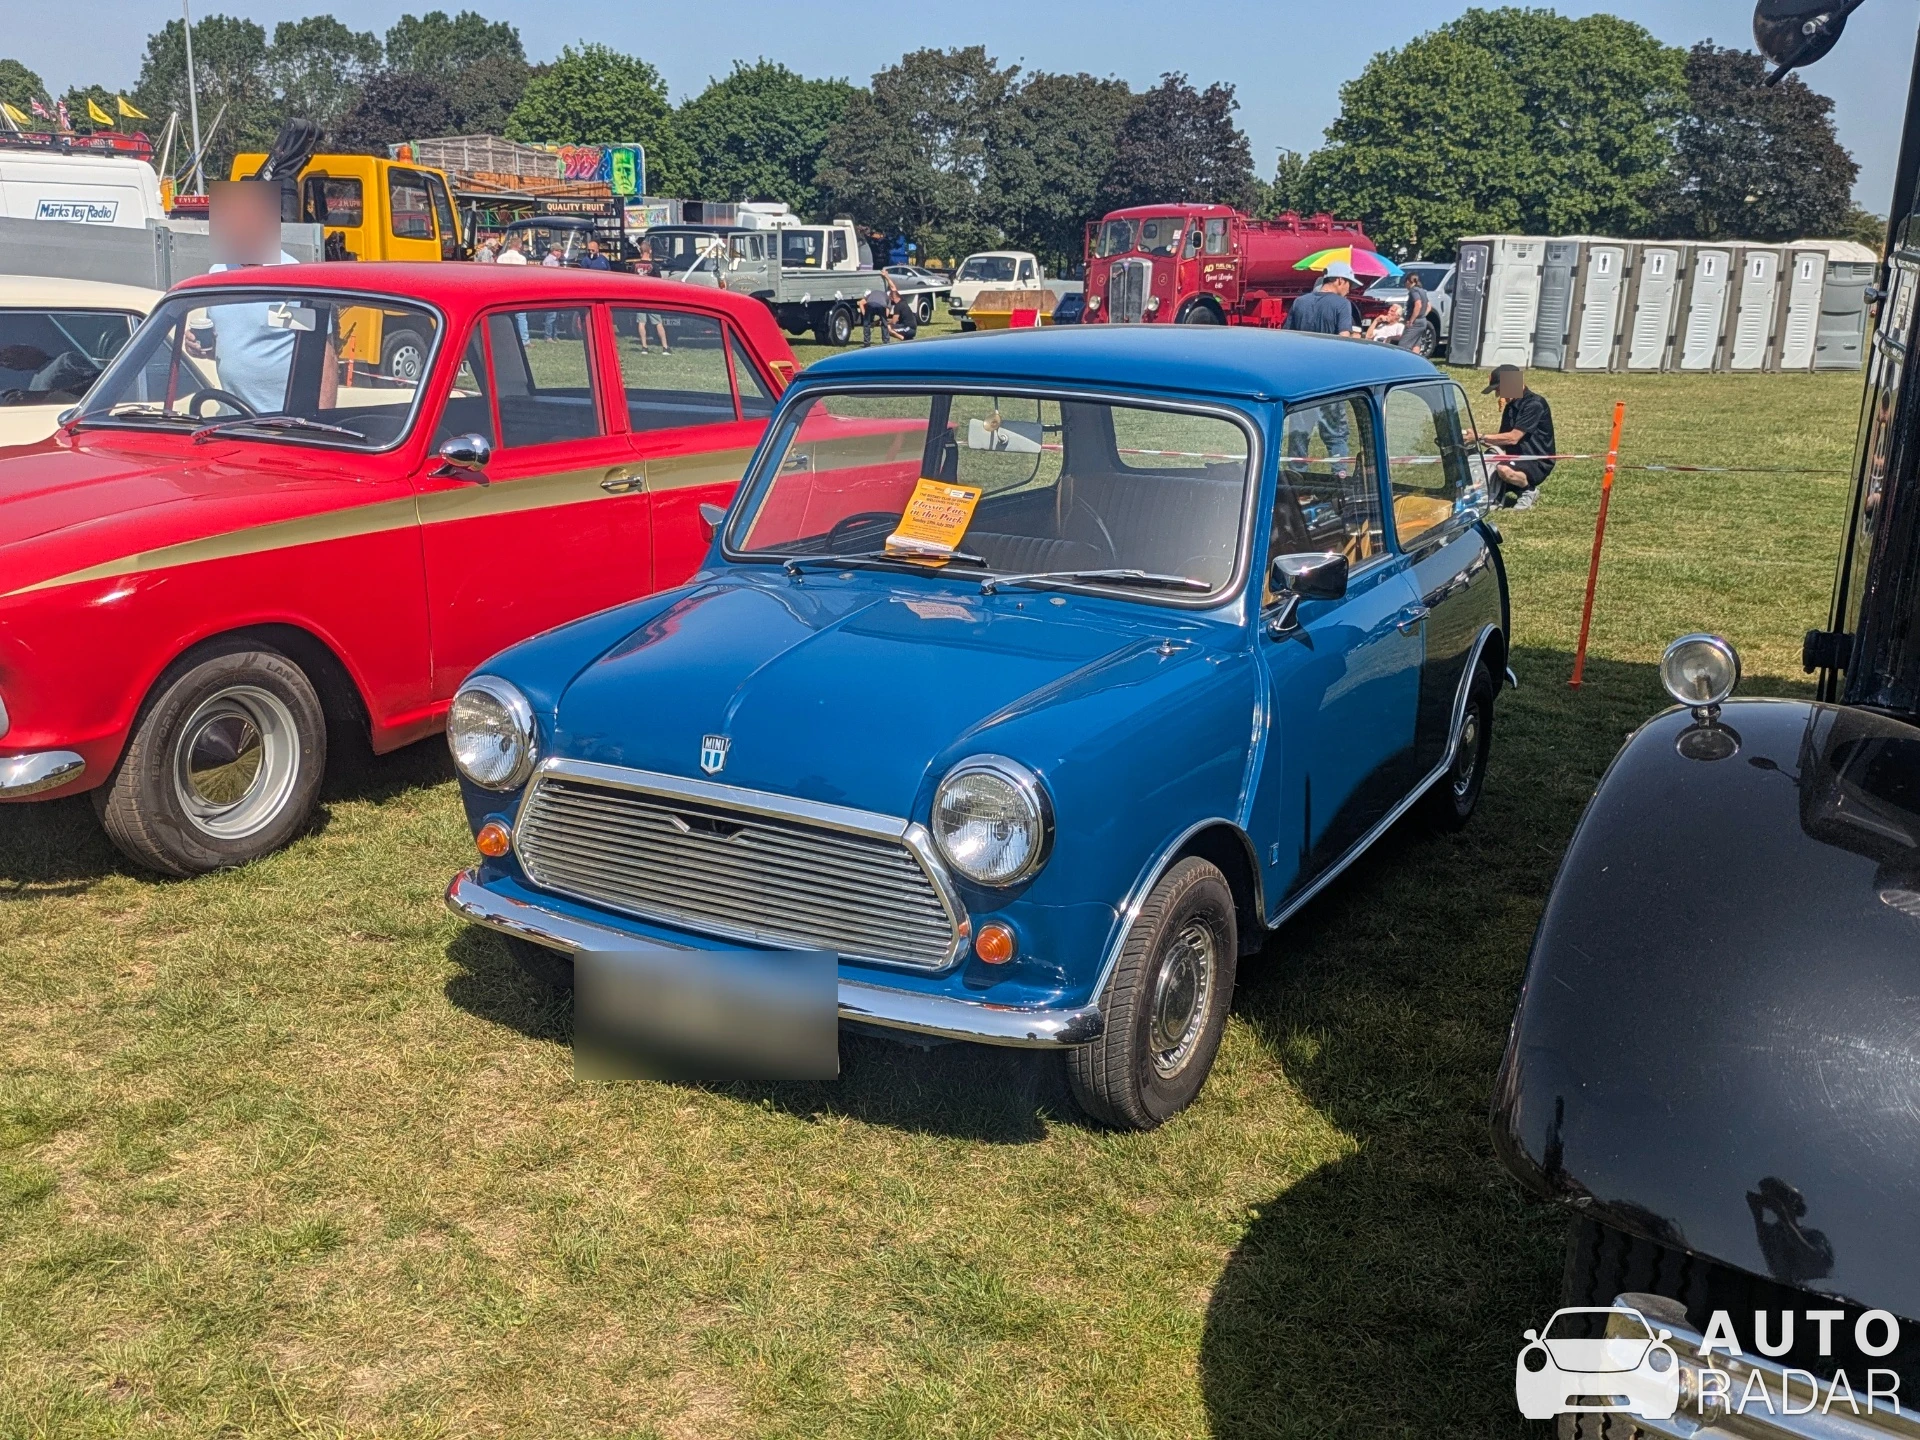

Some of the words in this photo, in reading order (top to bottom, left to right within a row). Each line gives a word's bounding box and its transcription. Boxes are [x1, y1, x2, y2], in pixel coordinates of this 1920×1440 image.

[39, 203, 70, 219] Marks
[68, 204, 87, 219] Tey
[87, 204, 112, 219] Radio
[546, 202, 581, 212] QUALITY
[582, 203, 605, 211] FRUIT
[1203, 264, 1214, 274] AD
[913, 500, 944, 511] Classic
[946, 505, 967, 515] Cars
[922, 510, 937, 518] the
[938, 513, 963, 524] Park
[705, 737, 725, 751] MINI
